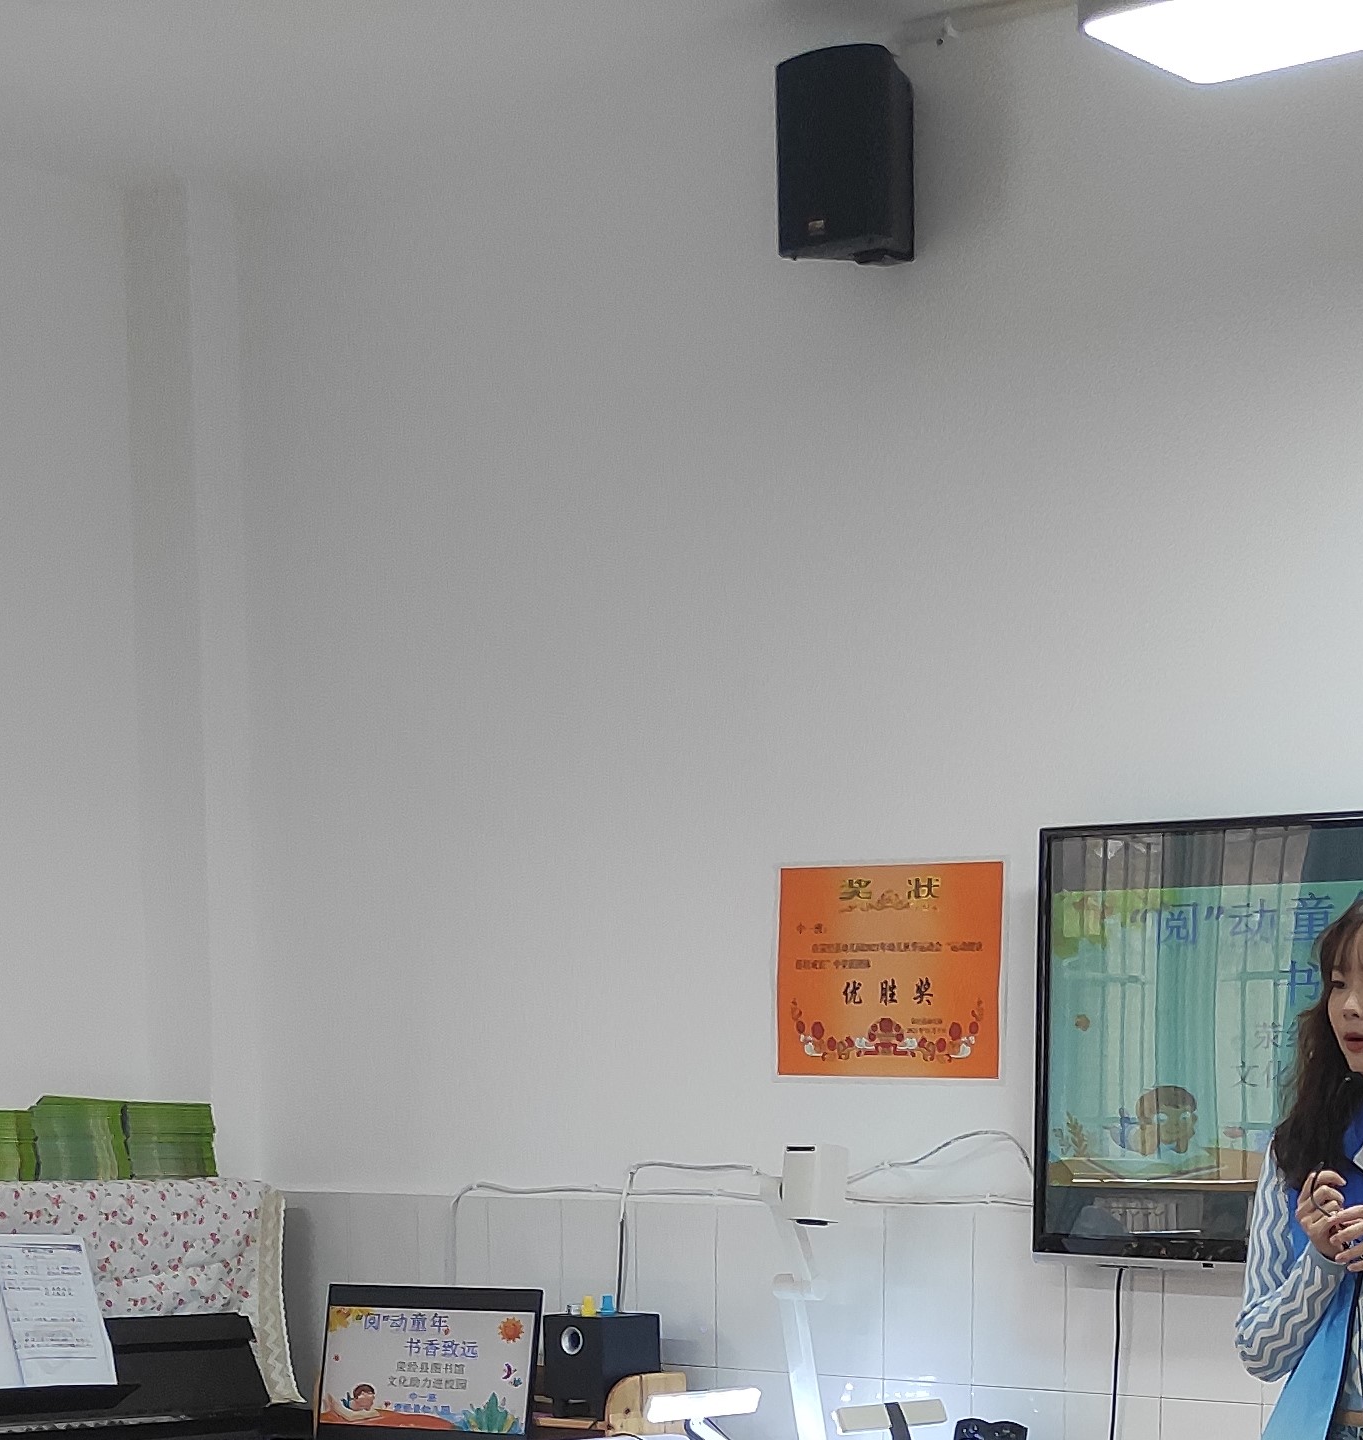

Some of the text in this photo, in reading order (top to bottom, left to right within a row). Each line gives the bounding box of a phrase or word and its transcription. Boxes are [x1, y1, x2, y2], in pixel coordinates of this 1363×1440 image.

[838, 876, 940, 900] 奖状
[1130, 889, 1363, 947] “阅”动童
[841, 977, 934, 1006] 优胜奖
[404, 1337, 479, 1359] 书香致远
